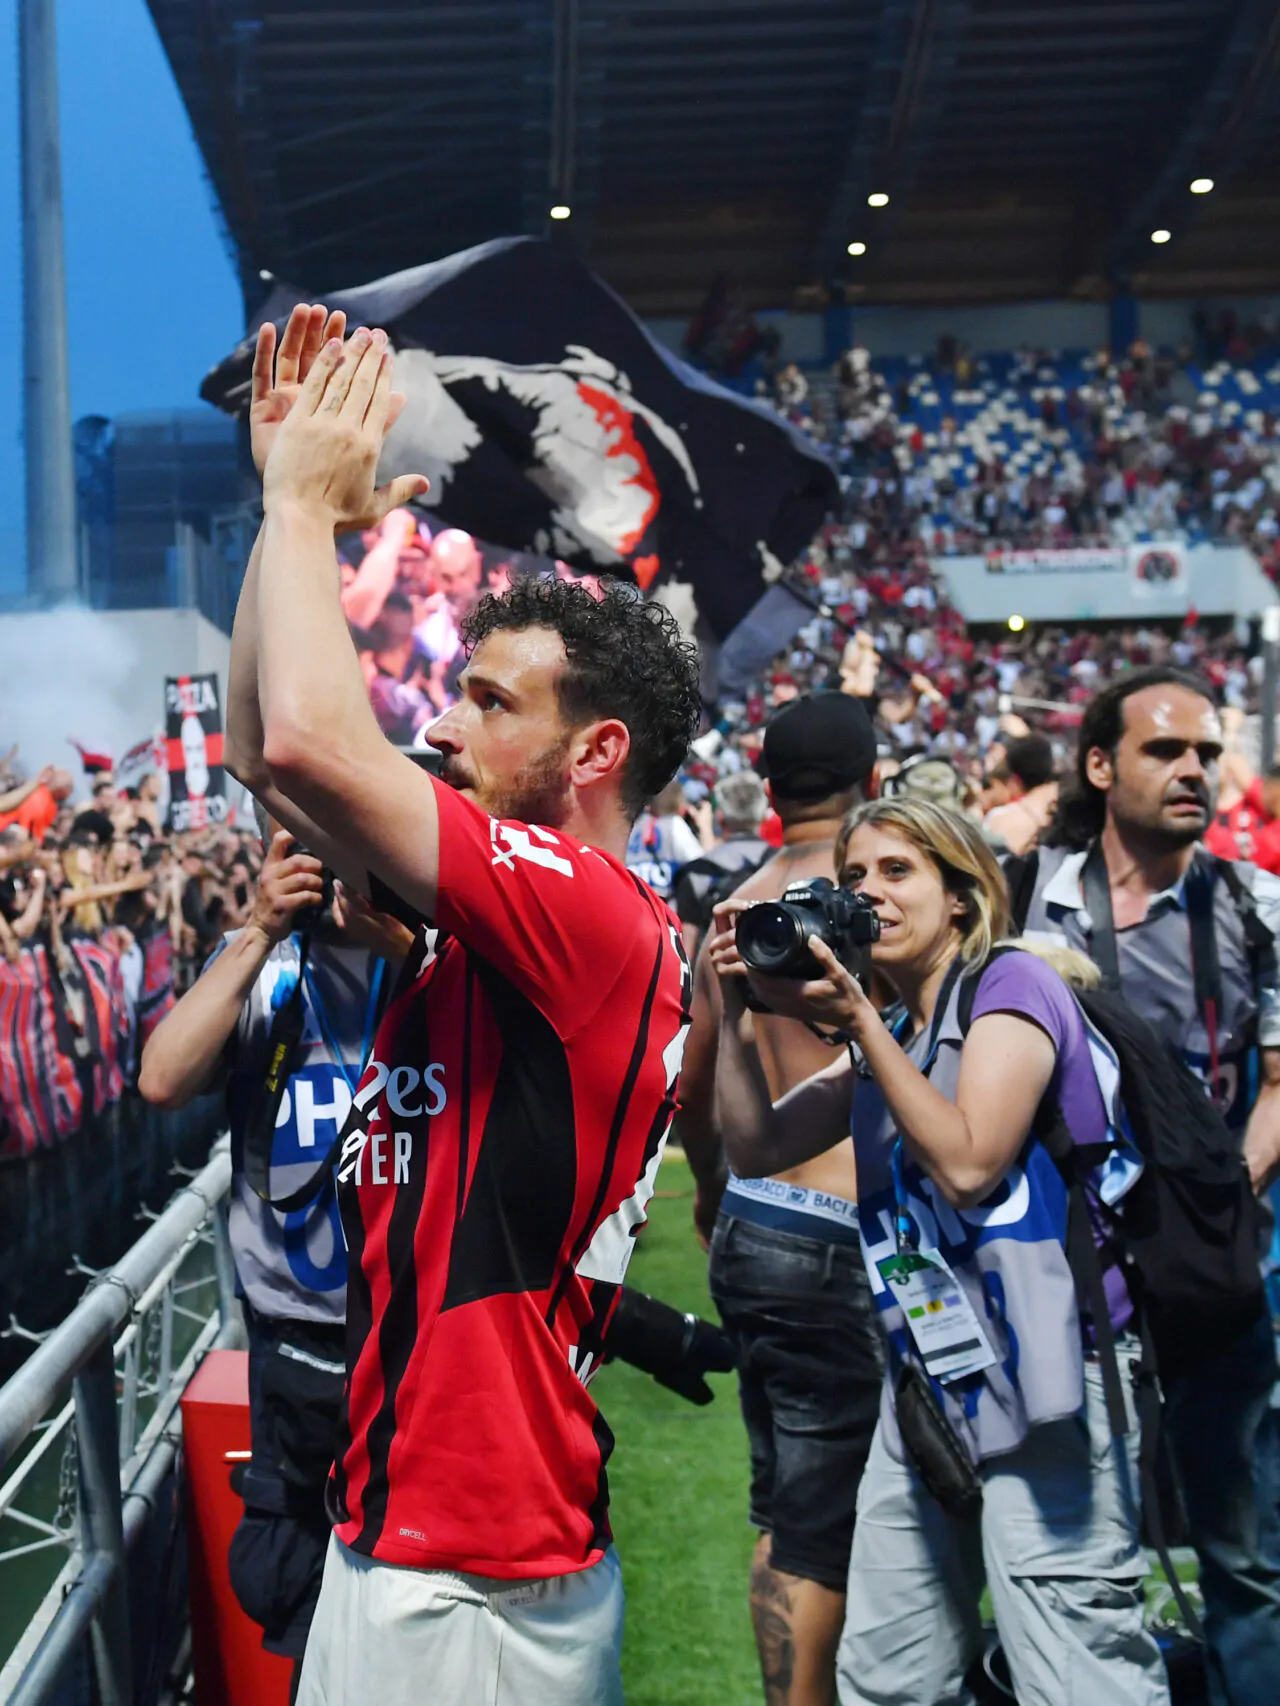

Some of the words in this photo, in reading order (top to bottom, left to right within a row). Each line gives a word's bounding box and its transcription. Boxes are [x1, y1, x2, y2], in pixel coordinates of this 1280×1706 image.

[785, 891, 812, 902] Nikon
[813, 1192, 848, 1215] BACI
[398, 1527, 427, 1542] DRYCELL
